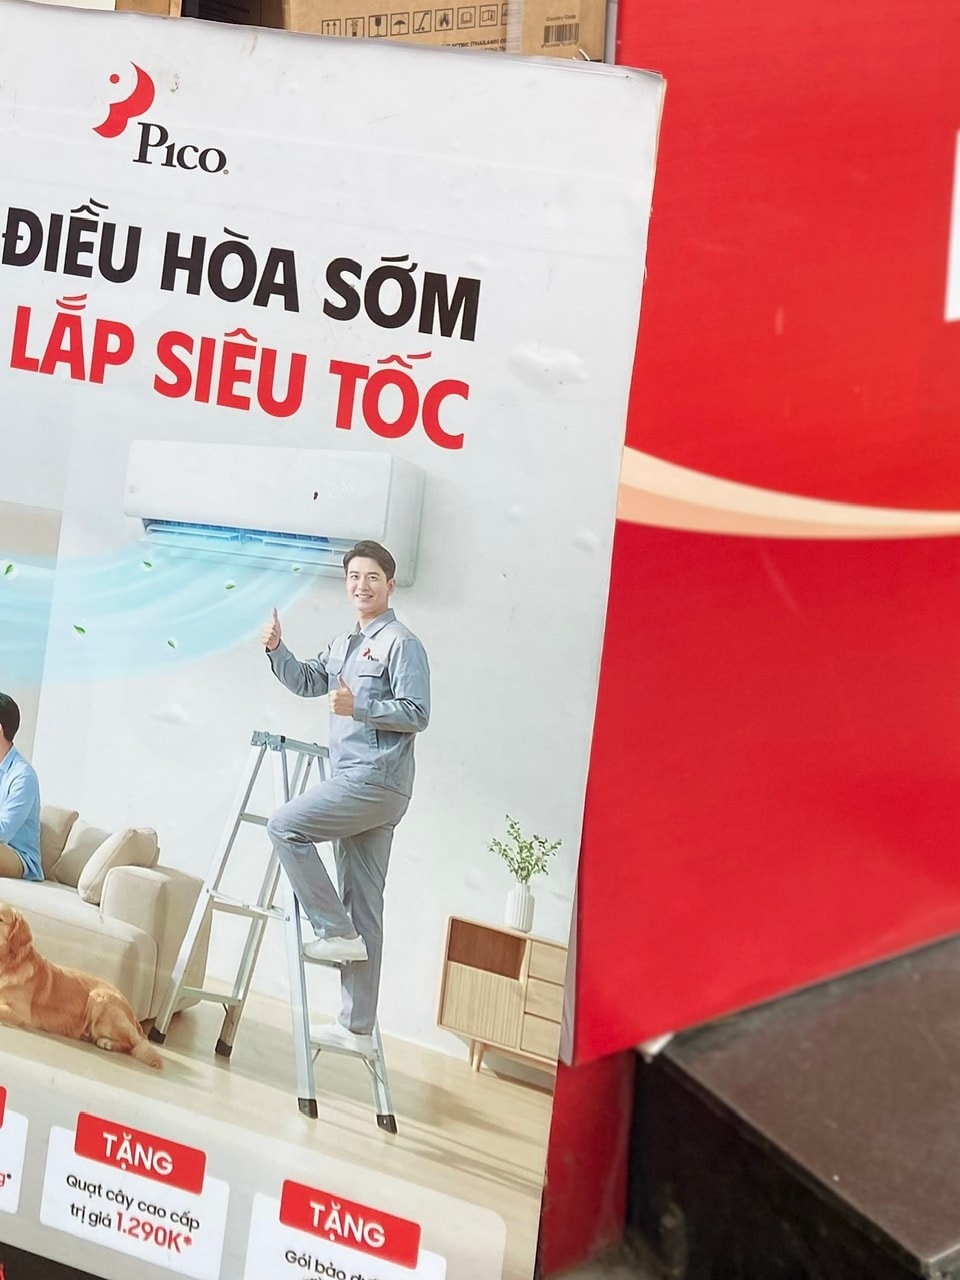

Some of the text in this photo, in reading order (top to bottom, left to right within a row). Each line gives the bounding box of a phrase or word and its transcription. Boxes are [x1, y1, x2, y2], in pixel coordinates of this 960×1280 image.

[132, 121, 227, 175] Pico
[2, 197, 143, 283] ĐIỀU
[160, 226, 300, 312] HÒA
[322, 254, 482, 342] SỚM
[9, 293, 135, 384] LẮP
[152, 327, 308, 418] SIÊU
[328, 351, 471, 450] TỐC
[103, 1132, 174, 1177] TẶNG
[65, 1172, 201, 1232] Quạt cây cao cấp
[69, 1202, 87, 1224] trị
[88, 1208, 112, 1230] giá
[308, 1199, 387, 1249] TẶNG
[285, 1249, 347, 1280] Gói bảo
